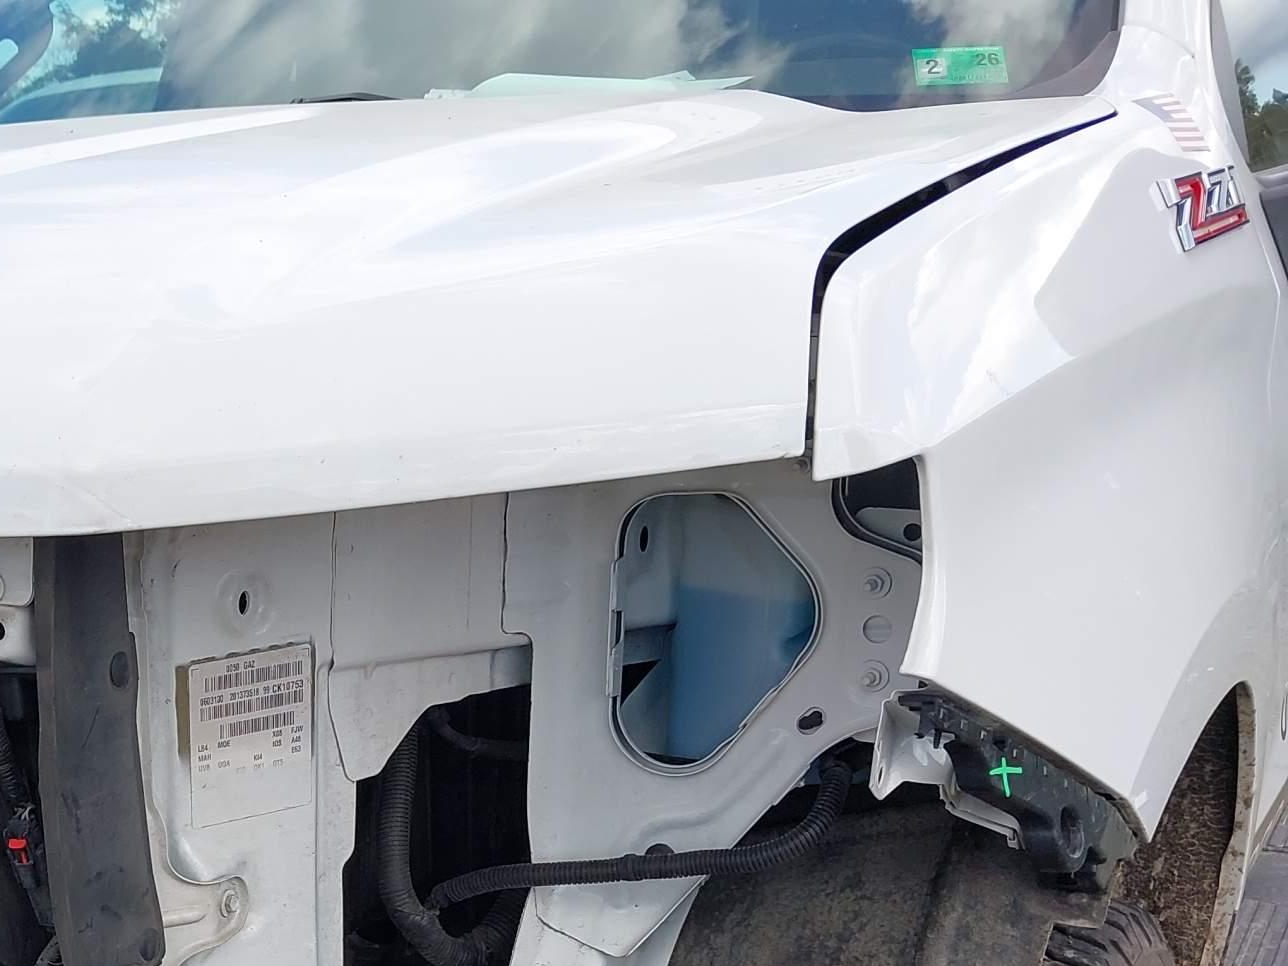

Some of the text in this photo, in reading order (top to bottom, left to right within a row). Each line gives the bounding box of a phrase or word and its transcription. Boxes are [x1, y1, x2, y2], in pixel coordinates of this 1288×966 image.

[925, 52, 1000, 75] 2 26
[272, 680, 304, 693] CK10753
